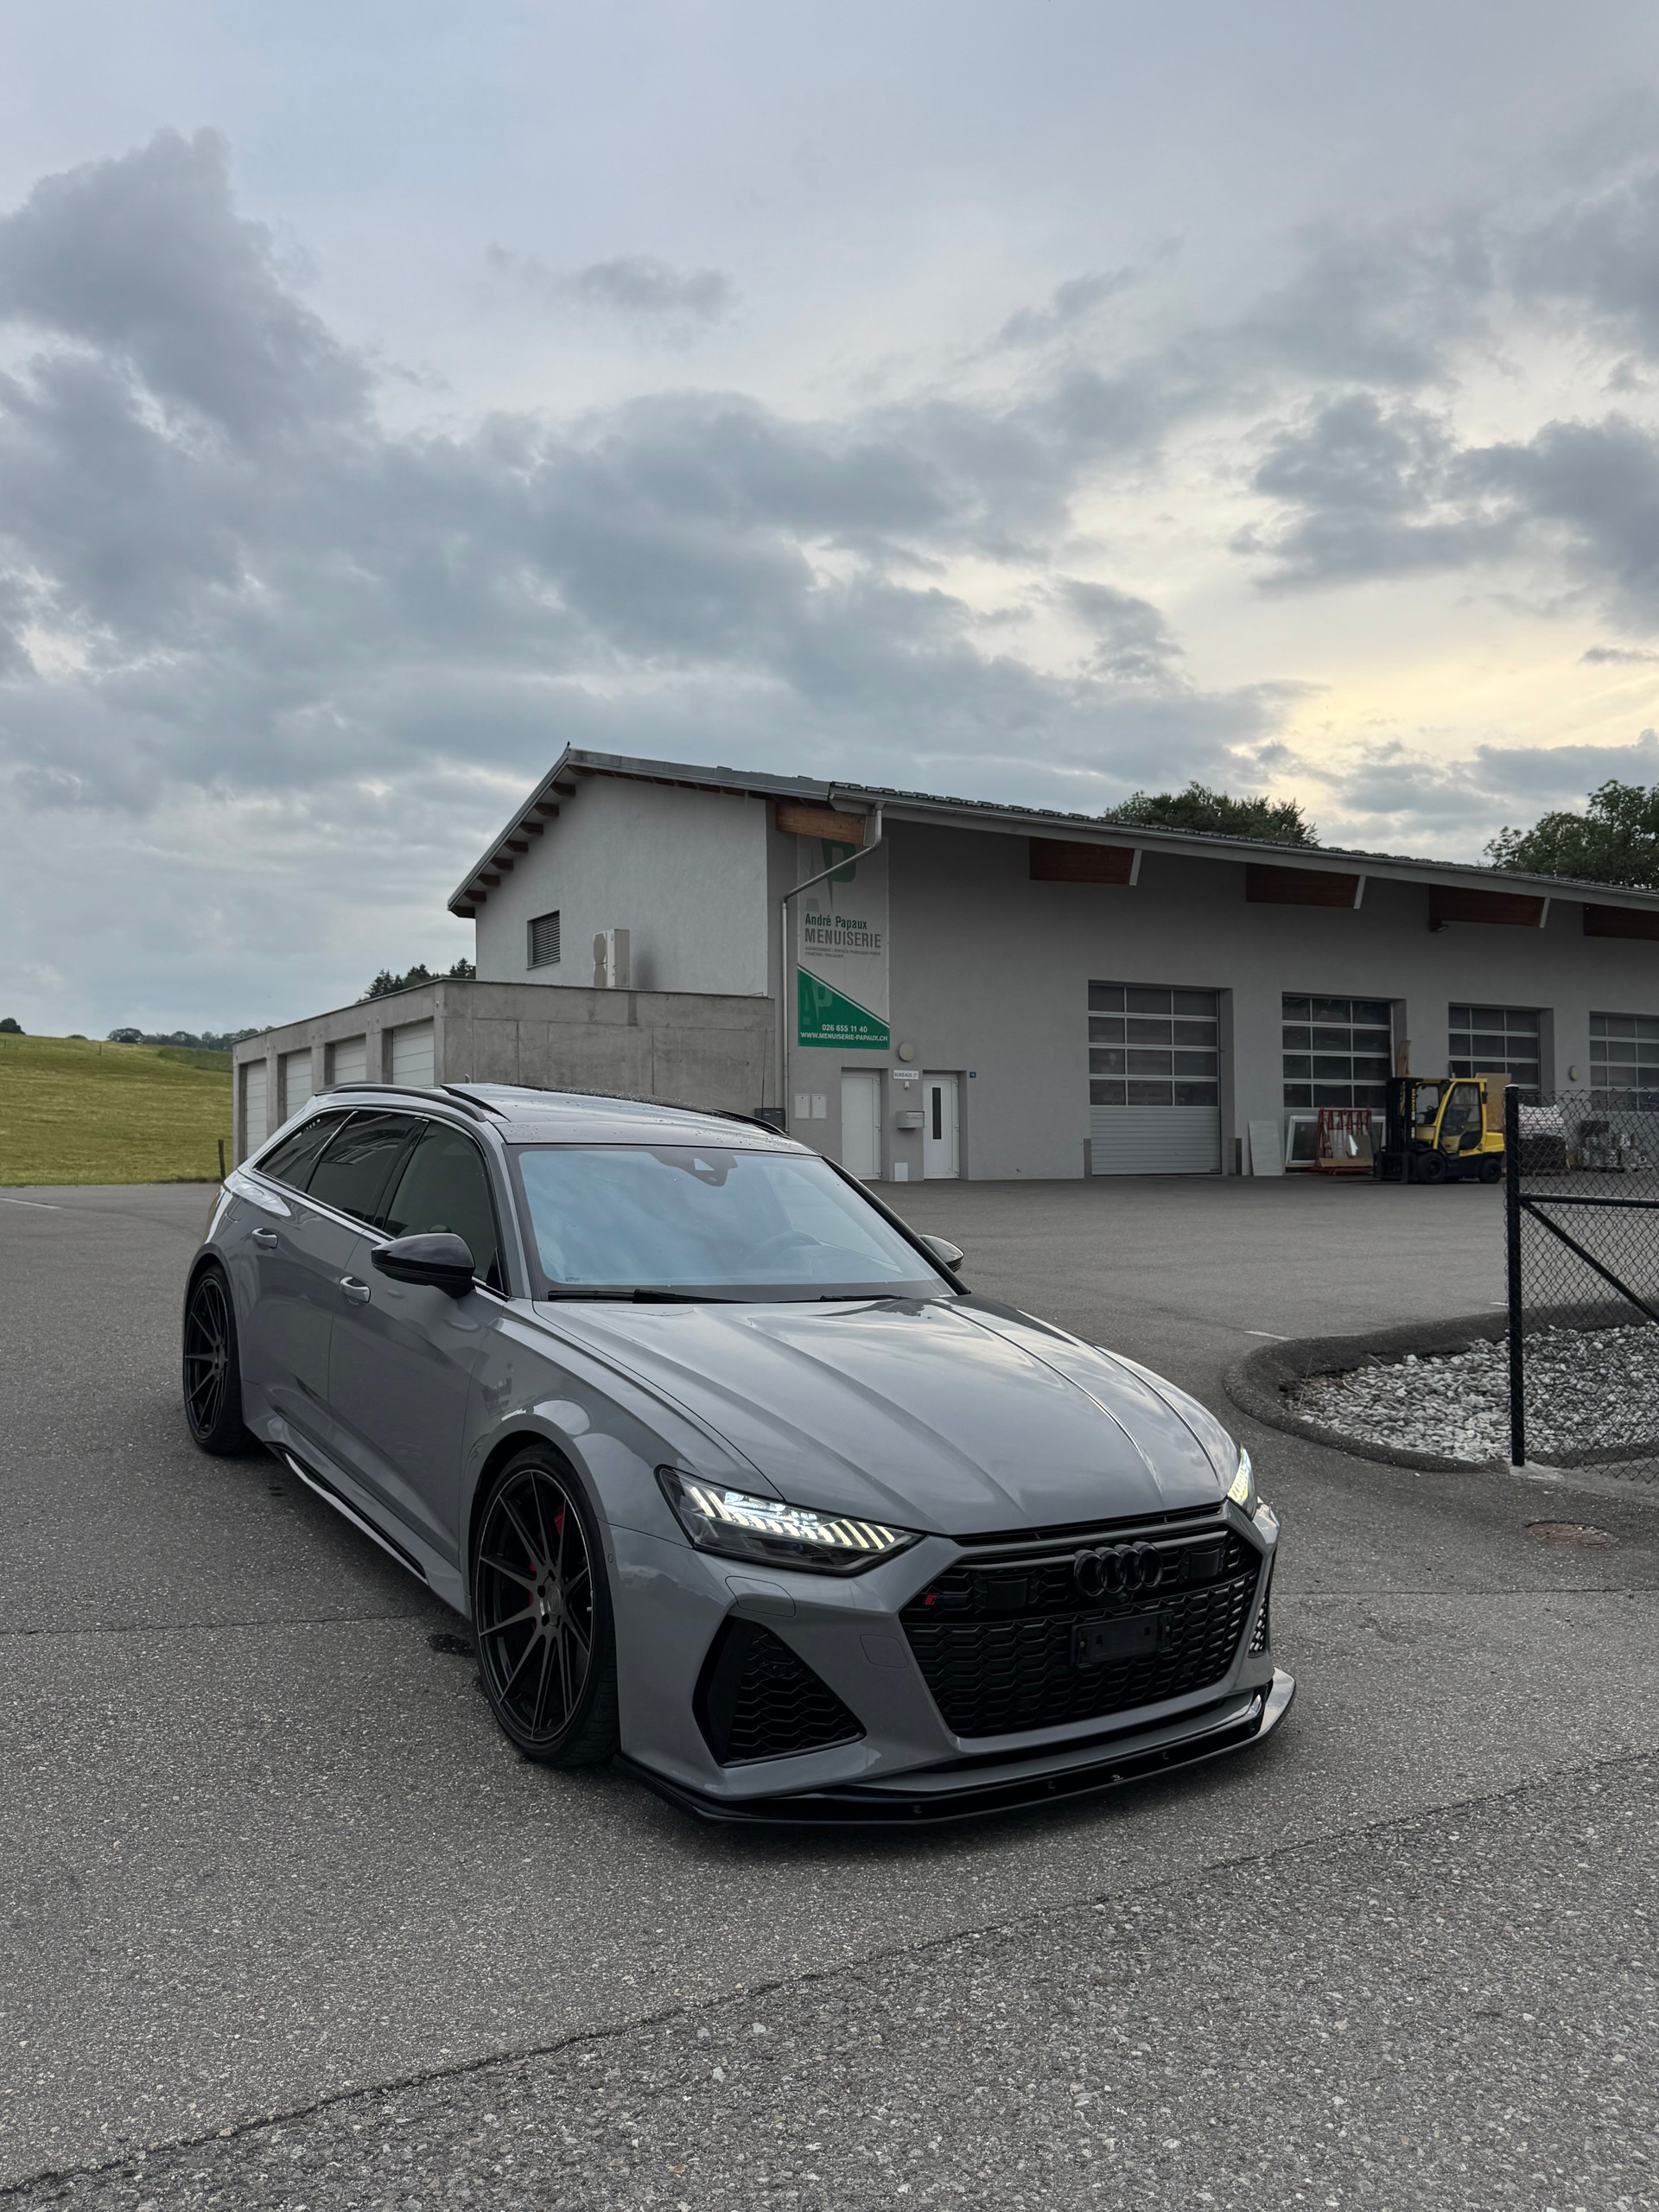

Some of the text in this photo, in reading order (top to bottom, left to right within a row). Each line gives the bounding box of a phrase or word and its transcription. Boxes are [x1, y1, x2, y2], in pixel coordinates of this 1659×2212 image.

[804, 912, 868, 931] André Papaux
[804, 927, 881, 948] MENUISERIE
[800, 1032, 888, 1042] WWW.MENUISERIE-PAPAUX.CH
